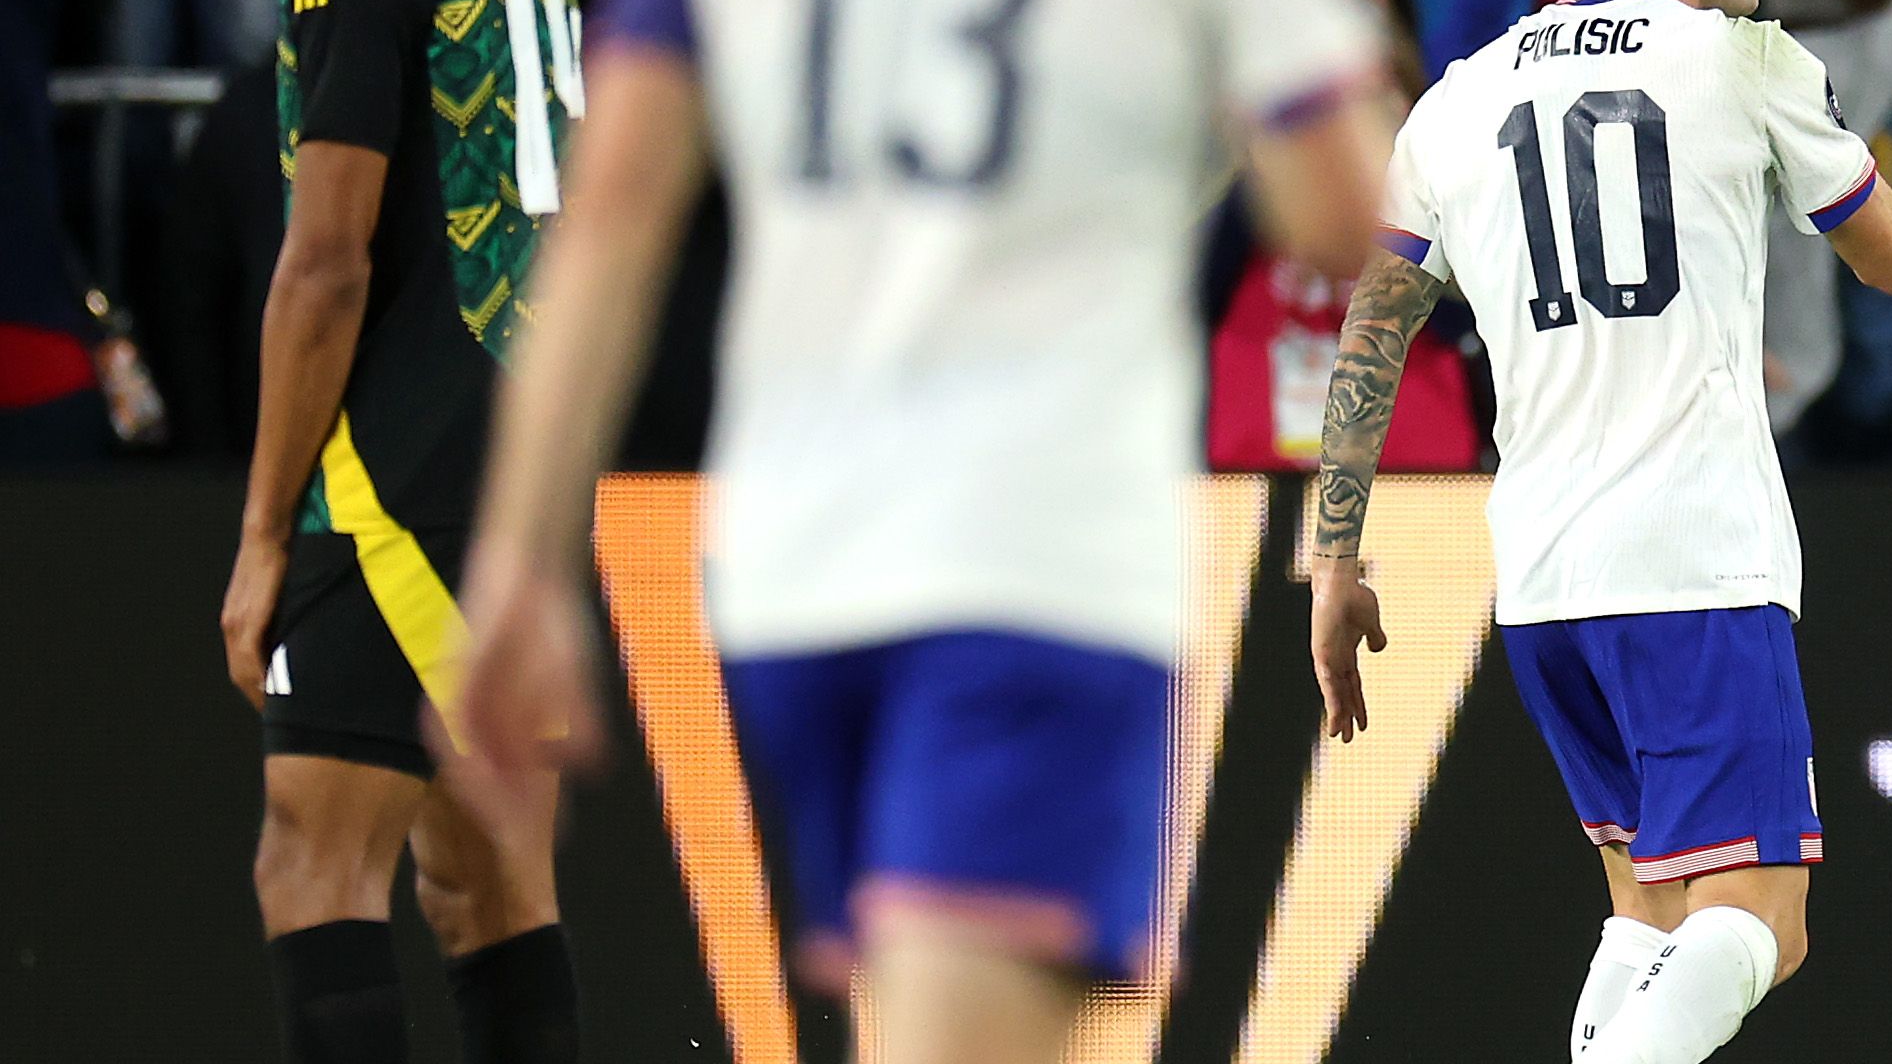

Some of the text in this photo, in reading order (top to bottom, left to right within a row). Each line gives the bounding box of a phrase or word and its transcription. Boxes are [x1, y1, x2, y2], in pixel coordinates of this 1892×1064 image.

[1513, 17, 1651, 71] PULISIC
[1496, 88, 1682, 333] 10
[1636, 945, 1677, 992] USA
